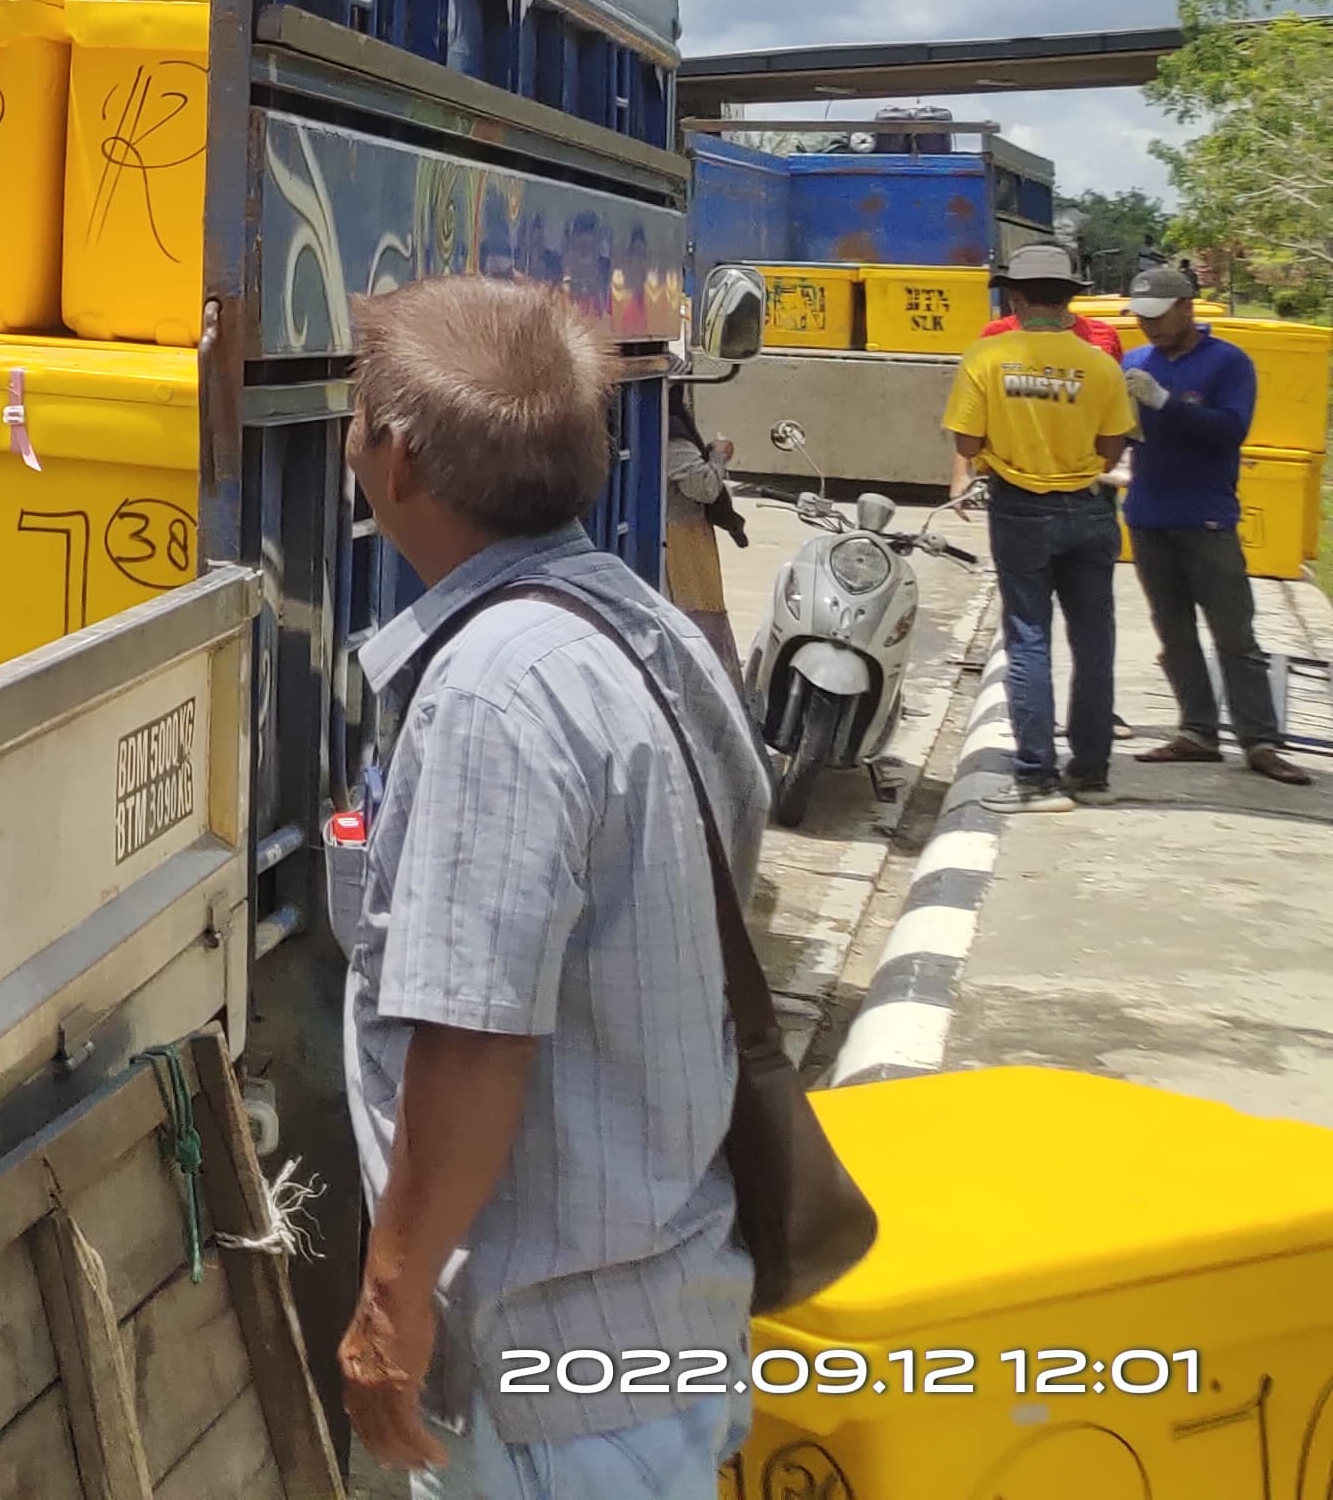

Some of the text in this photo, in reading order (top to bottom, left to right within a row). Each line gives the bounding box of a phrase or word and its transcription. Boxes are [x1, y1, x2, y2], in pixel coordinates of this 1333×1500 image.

[114, 511, 191, 573] 38
[117, 729, 149, 799] BDM
[116, 788, 148, 861] BTM
